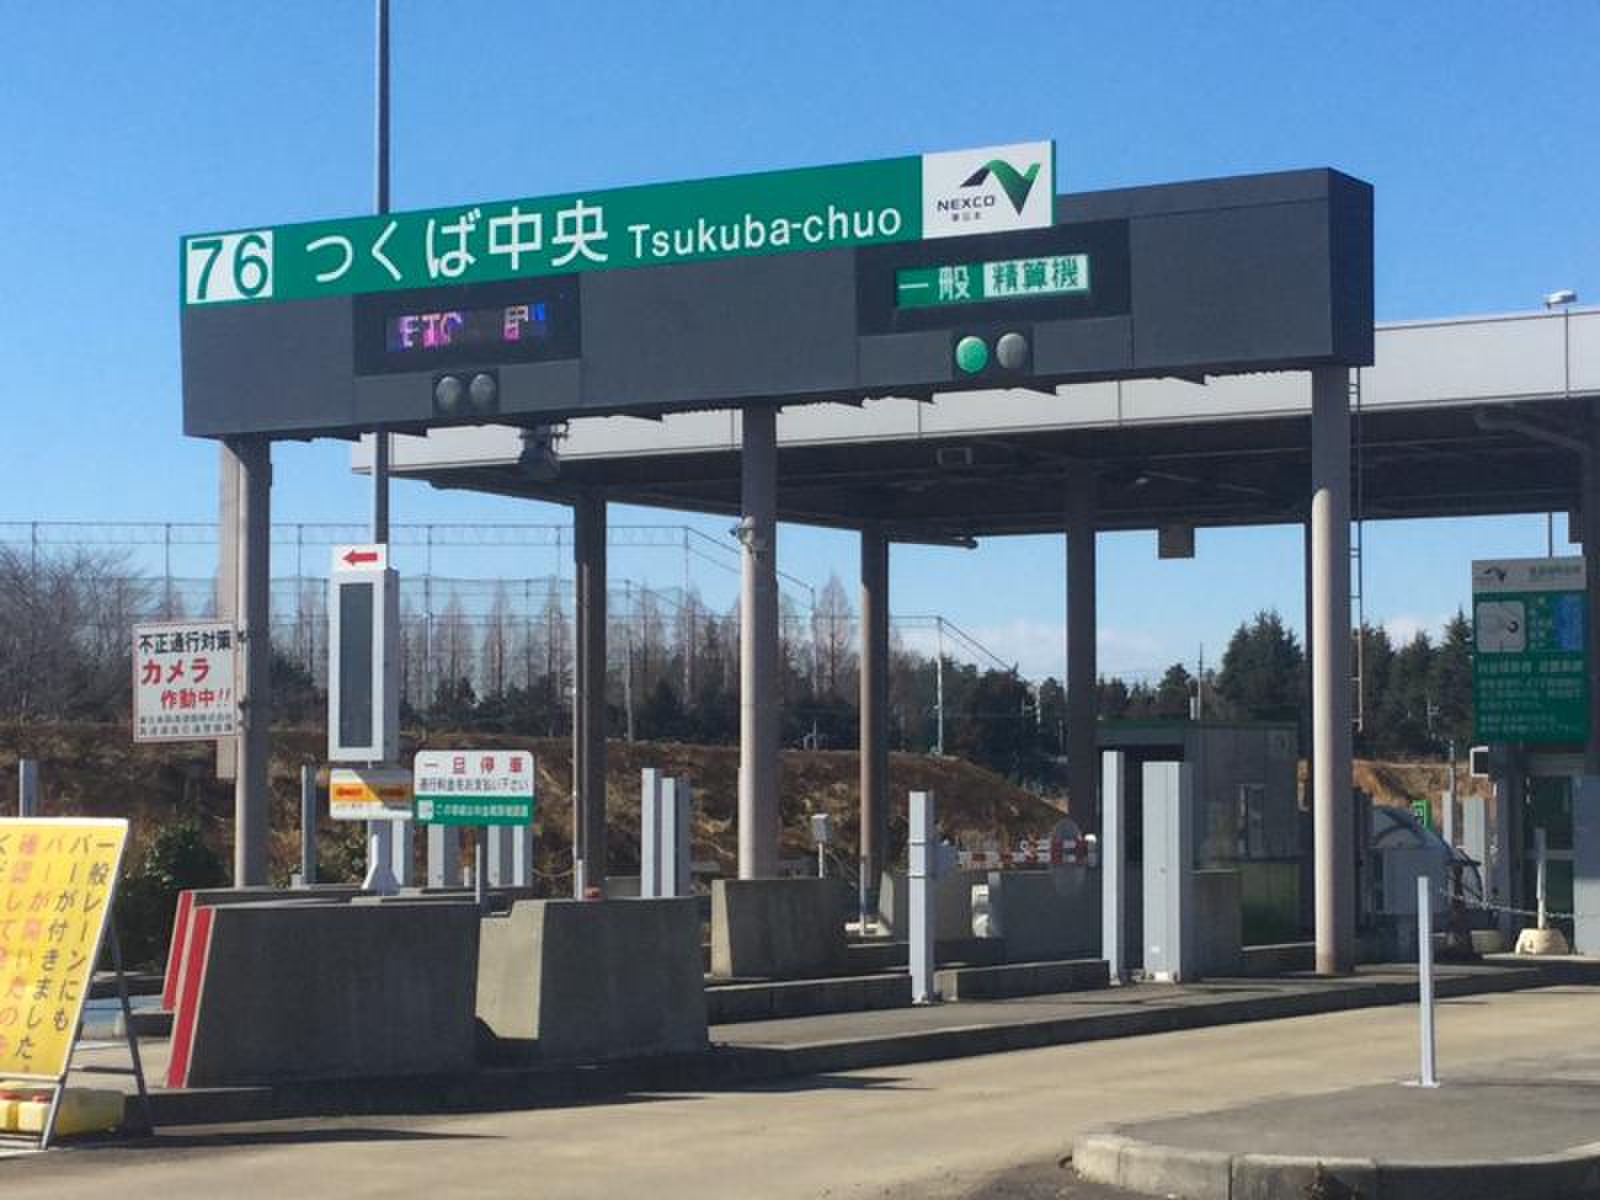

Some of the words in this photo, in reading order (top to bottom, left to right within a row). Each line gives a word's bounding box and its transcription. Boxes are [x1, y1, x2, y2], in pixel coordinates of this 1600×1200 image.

[937, 195, 995, 212] NEXCO
[189, 233, 270, 300] 76
[305, 199, 609, 281] つくば中央
[627, 205, 901, 259] Tsukuba-chuo
[898, 266, 971, 301] 一般
[992, 257, 1079, 294] 精算機
[141, 657, 210, 685] カメラ
